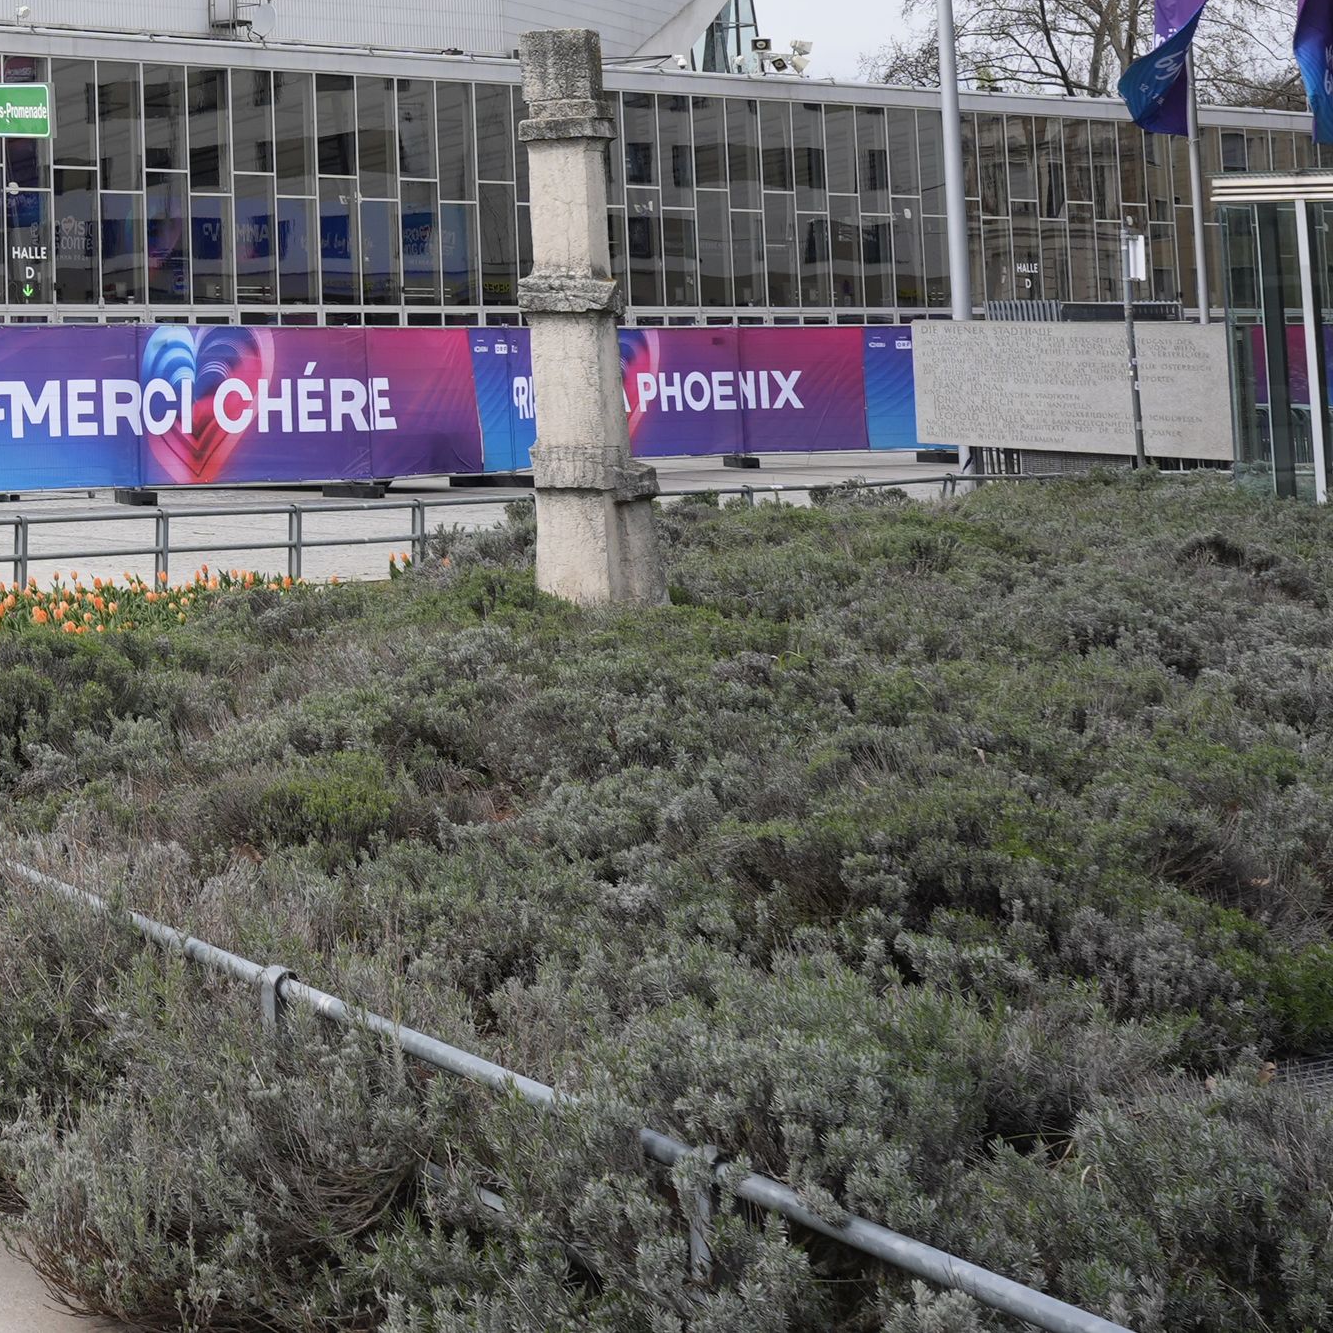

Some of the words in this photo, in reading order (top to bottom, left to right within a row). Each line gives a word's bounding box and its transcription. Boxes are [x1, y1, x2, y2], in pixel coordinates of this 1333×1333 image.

[12, 247, 47, 259] HALLE
[25, 266, 35, 279] D
[1016, 263, 1038, 273] HALLE
[1025, 278, 1032, 288] D
[921, 326, 937, 334] DIE
[944, 326, 986, 335] WIENER
[993, 326, 1053, 336] STADTHALLE
[636, 370, 805, 413] PHOENIX
